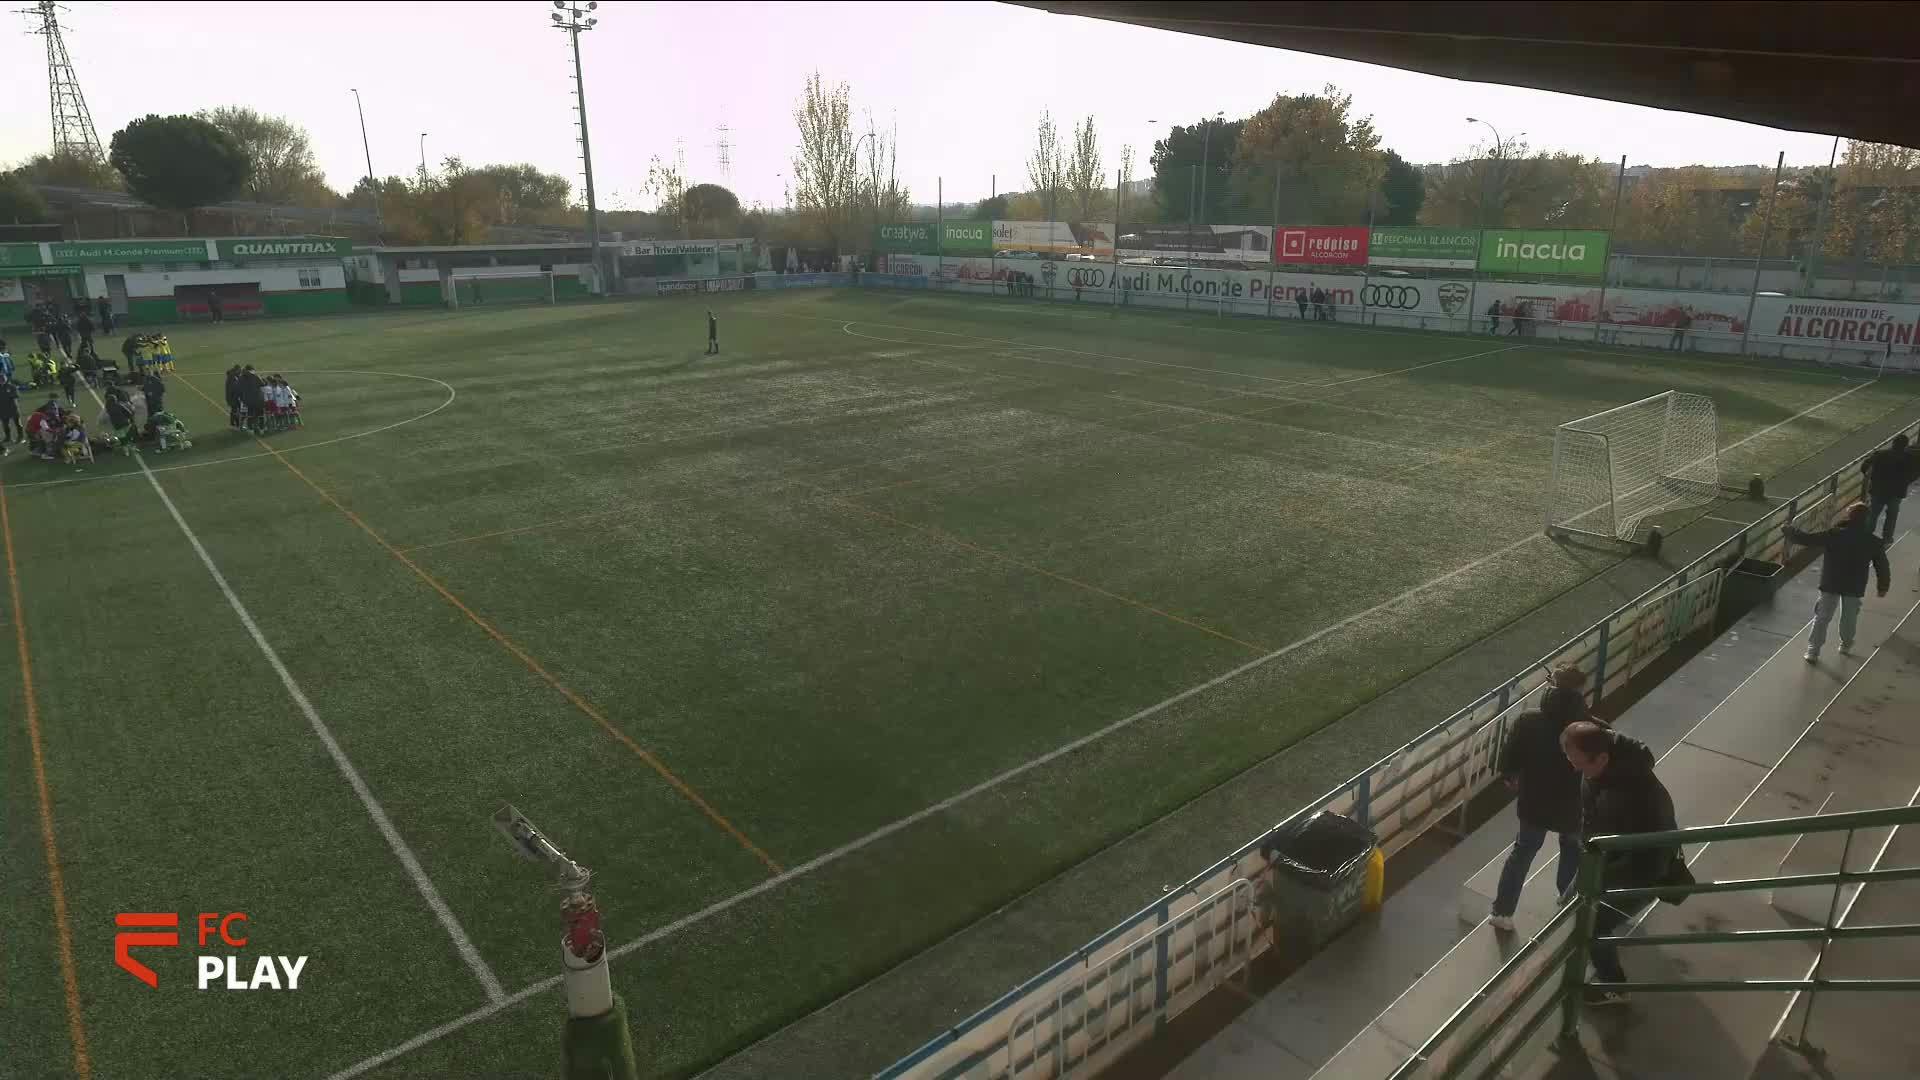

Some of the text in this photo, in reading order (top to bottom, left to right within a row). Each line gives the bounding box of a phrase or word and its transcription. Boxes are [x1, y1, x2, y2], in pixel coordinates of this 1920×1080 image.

[946, 226, 983, 240] inacua
[233, 242, 337, 255] QUAMTRAX
[635, 246, 650, 255] Bar
[1309, 237, 1358, 251] redpiso
[1496, 237, 1586, 261] inacua
[1250, 278, 1354, 305] Premim
[1785, 303, 1868, 319] AYUNTAMIENTO
